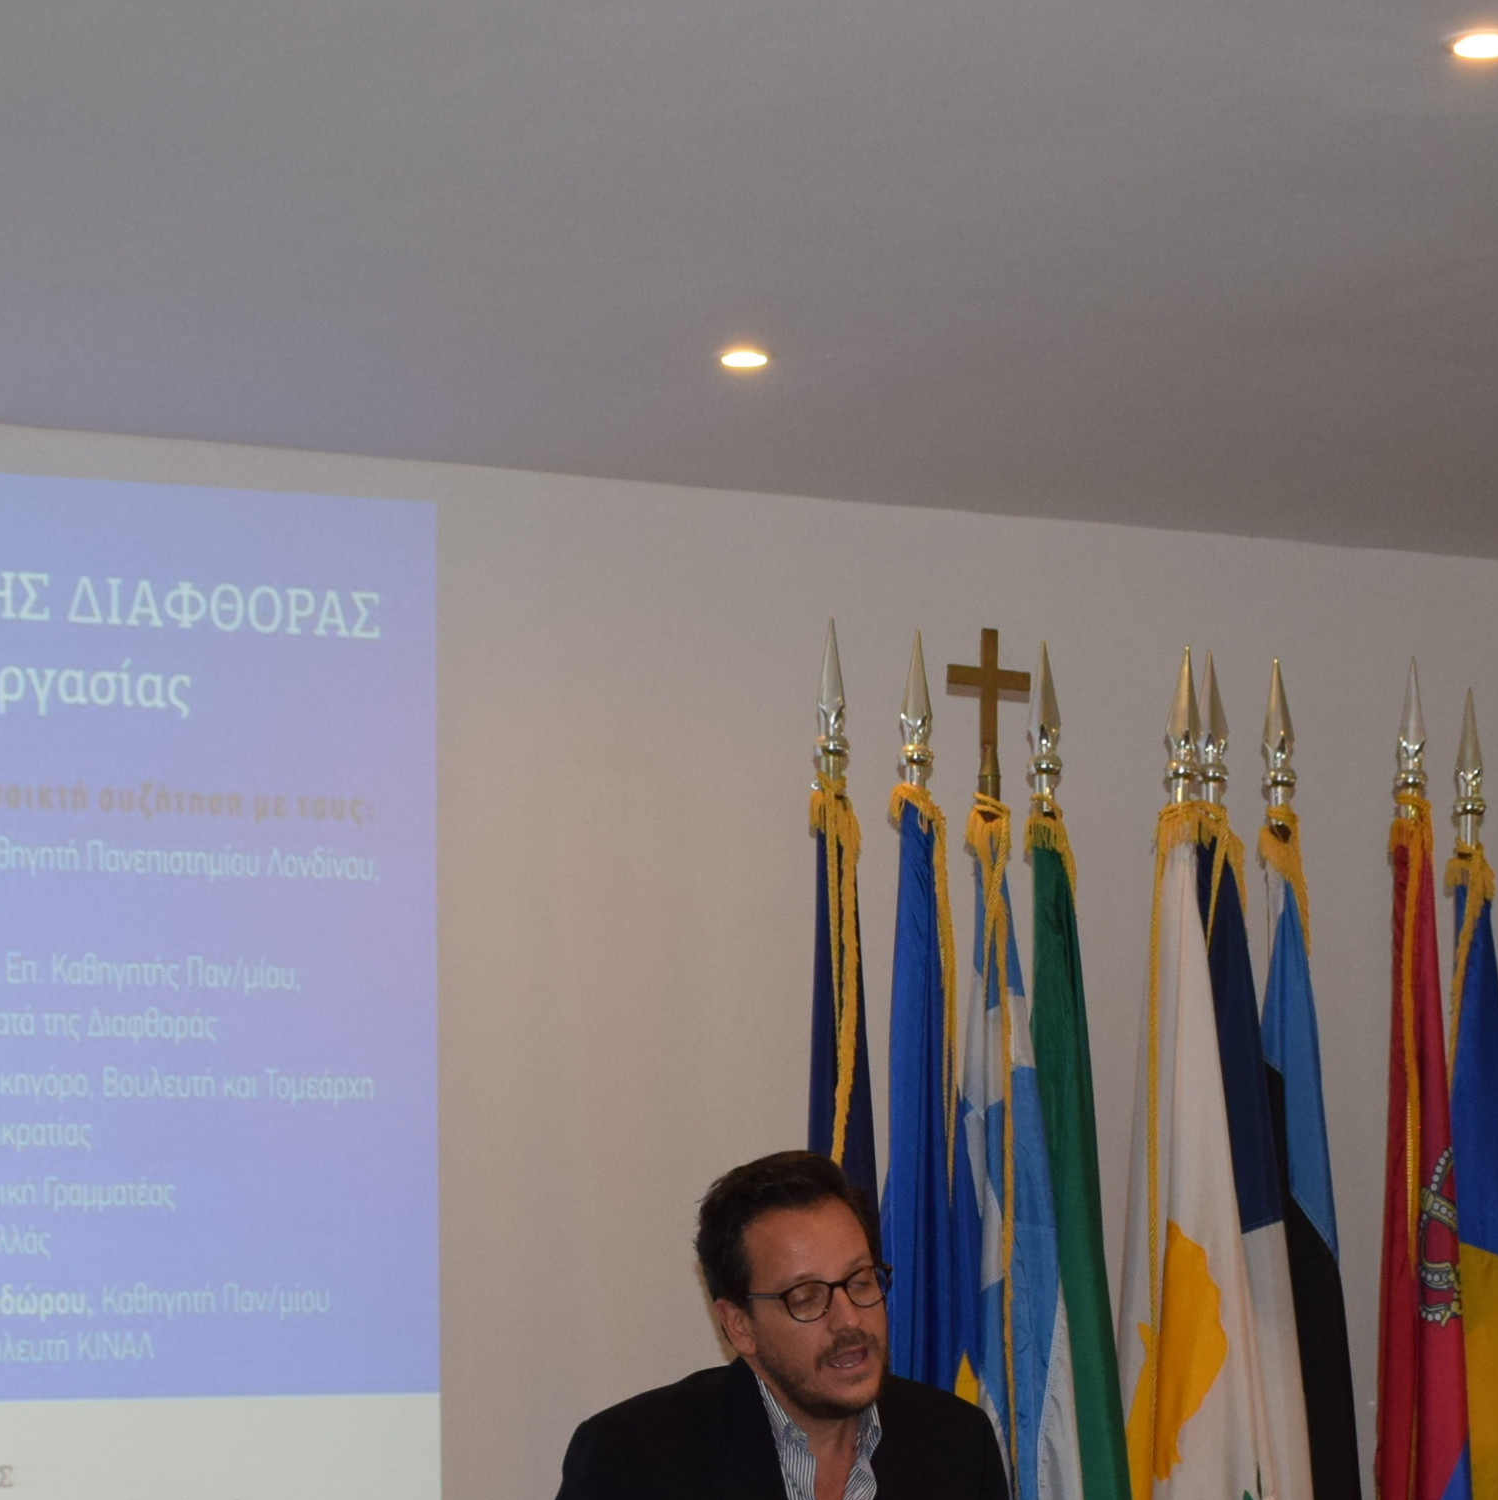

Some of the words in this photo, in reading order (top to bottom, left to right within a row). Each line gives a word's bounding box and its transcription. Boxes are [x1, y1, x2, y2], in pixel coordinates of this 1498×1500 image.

[65, 573, 382, 640] ΔΙΑΦΘΟΡΑΣ
[253, 793, 285, 824] με
[87, 842, 260, 884] Πανεπιστημίου
[266, 846, 380, 883] Λονδίνου,
[51, 954, 179, 992] Καθηγητής
[43, 1010, 81, 1040] της
[87, 1008, 217, 1043] Διαφθοράς
[103, 1065, 216, 1101] Βουλευτή
[224, 1074, 258, 1100] και
[265, 1068, 374, 1106] Τομεάρχη
[44, 1176, 177, 1211] Γραμματέας
[103, 1283, 216, 1320] Καθηγητή
[224, 1282, 330, 1320] Παν/μίου
[78, 1332, 153, 1362] ΚΙΝΑΛ
